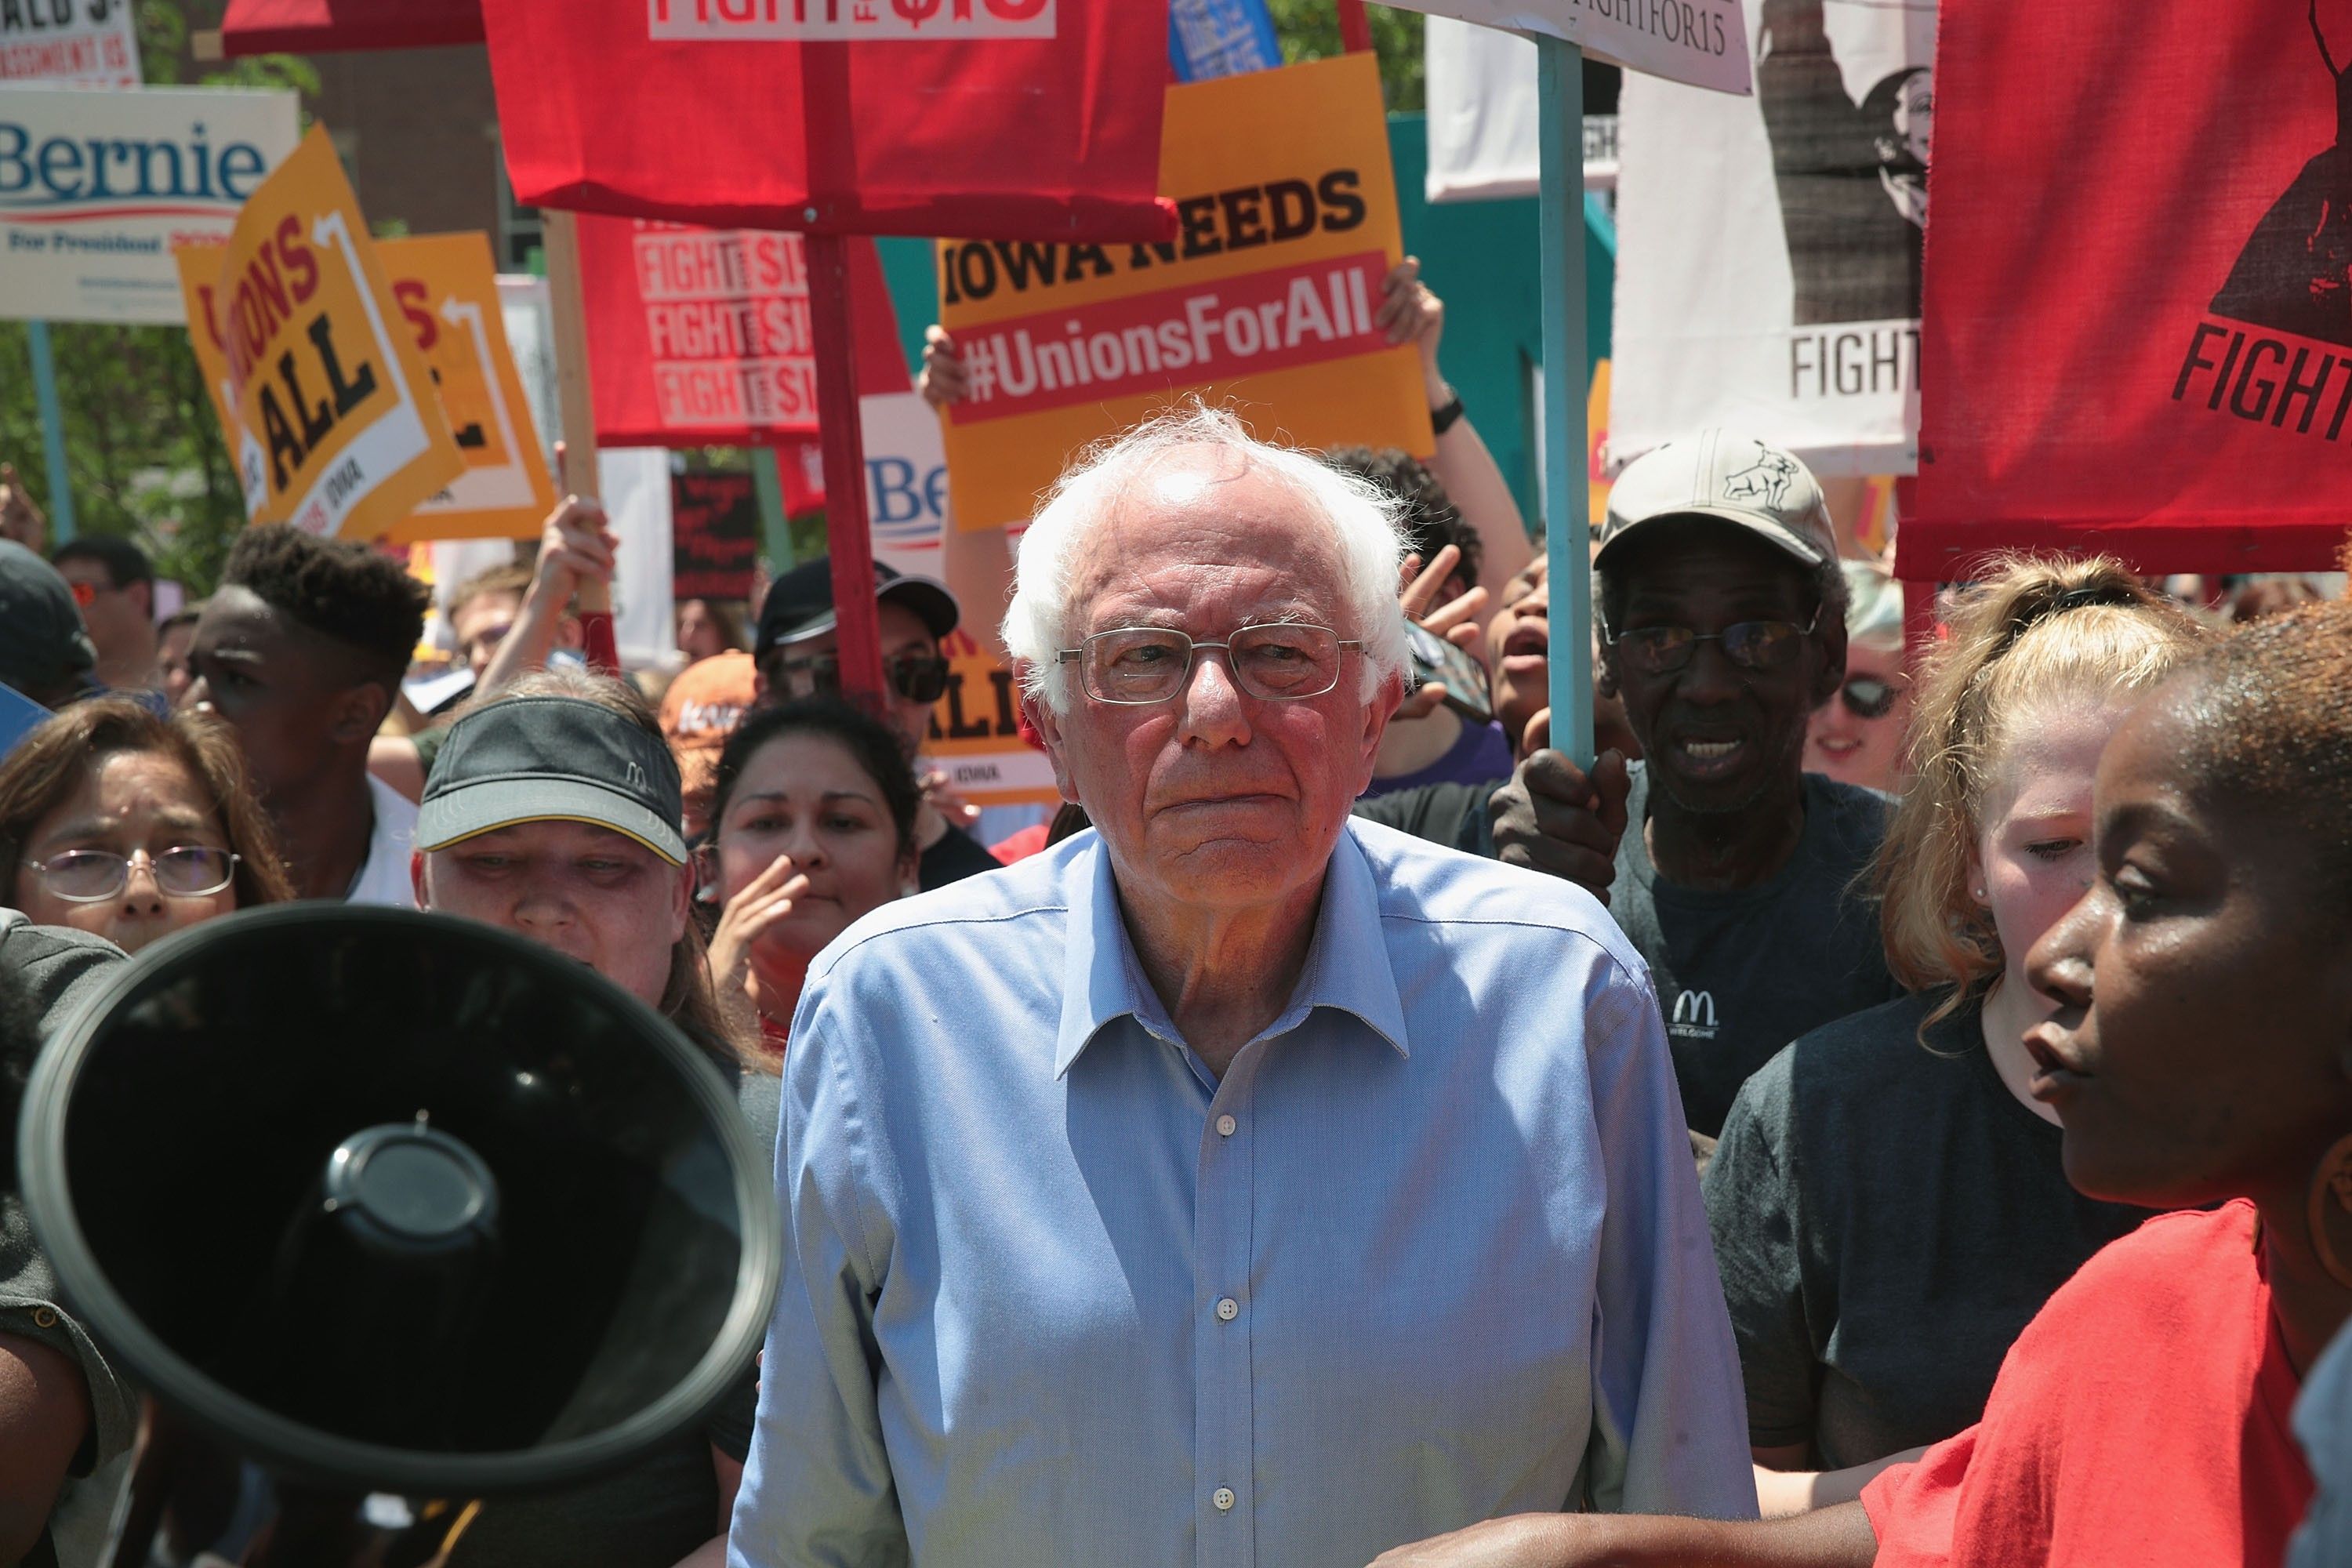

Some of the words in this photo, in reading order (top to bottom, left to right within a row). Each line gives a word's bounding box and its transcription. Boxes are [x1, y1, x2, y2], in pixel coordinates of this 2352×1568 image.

[963, 267, 1374, 401] #UnionsForAll
[2171, 321, 2352, 442] FIGHT
[257, 312, 378, 495] ALL
